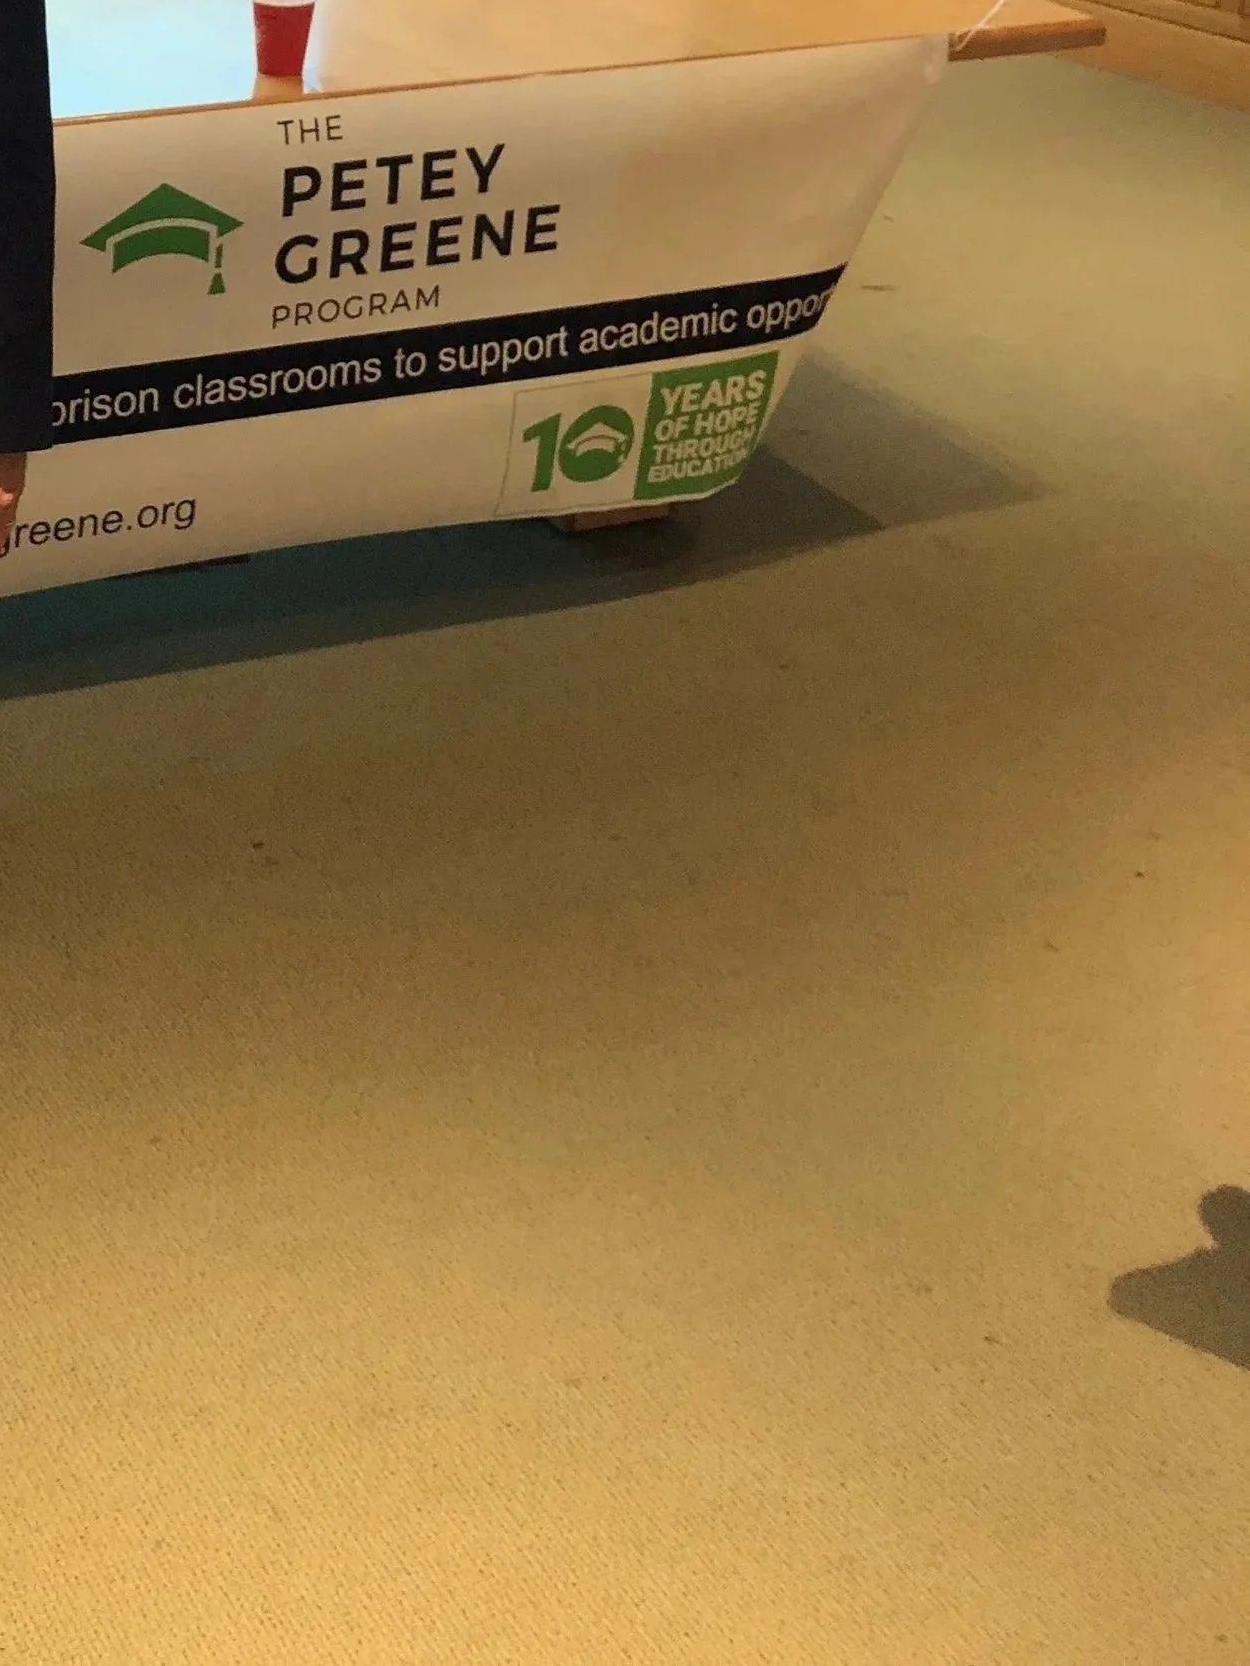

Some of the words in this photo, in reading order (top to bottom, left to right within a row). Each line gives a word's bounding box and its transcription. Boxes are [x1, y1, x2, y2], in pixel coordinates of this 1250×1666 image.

[276, 114, 345, 146] THE
[280, 143, 506, 217] PETEY
[273, 204, 562, 284] GREENE
[271, 284, 441, 329] PROGRAM
[172, 354, 383, 411] classrooms
[394, 347, 427, 380] to
[437, 326, 569, 377] support
[579, 302, 738, 355] academic
[660, 369, 767, 415] YEARS
[653, 424, 756, 463] THROUGH
[654, 415, 690, 442] OF
[693, 400, 762, 436] HOPE
[0, 498, 197, 558] reene.org
